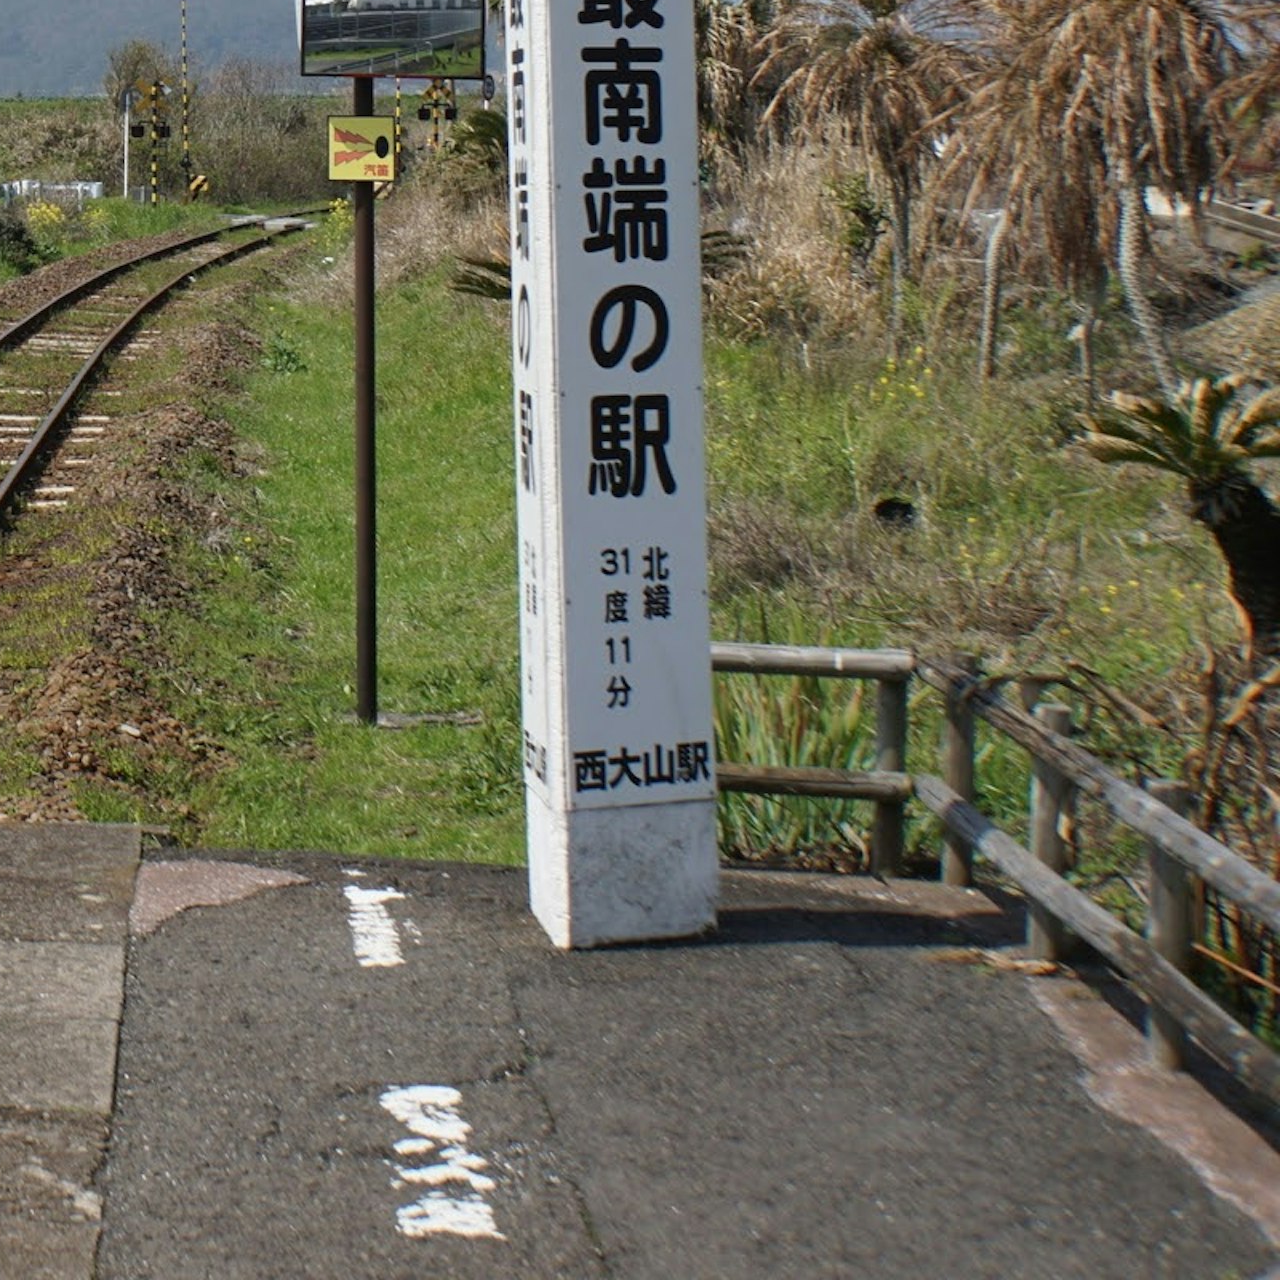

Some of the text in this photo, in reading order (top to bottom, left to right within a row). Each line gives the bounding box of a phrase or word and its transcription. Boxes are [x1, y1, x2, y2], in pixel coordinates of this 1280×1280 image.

[364, 163, 389, 177] 汽笛
[641, 545, 672, 621] 北緯
[599, 547, 632, 709] 31度11分
[572, 740, 710, 792] 西大山駅
